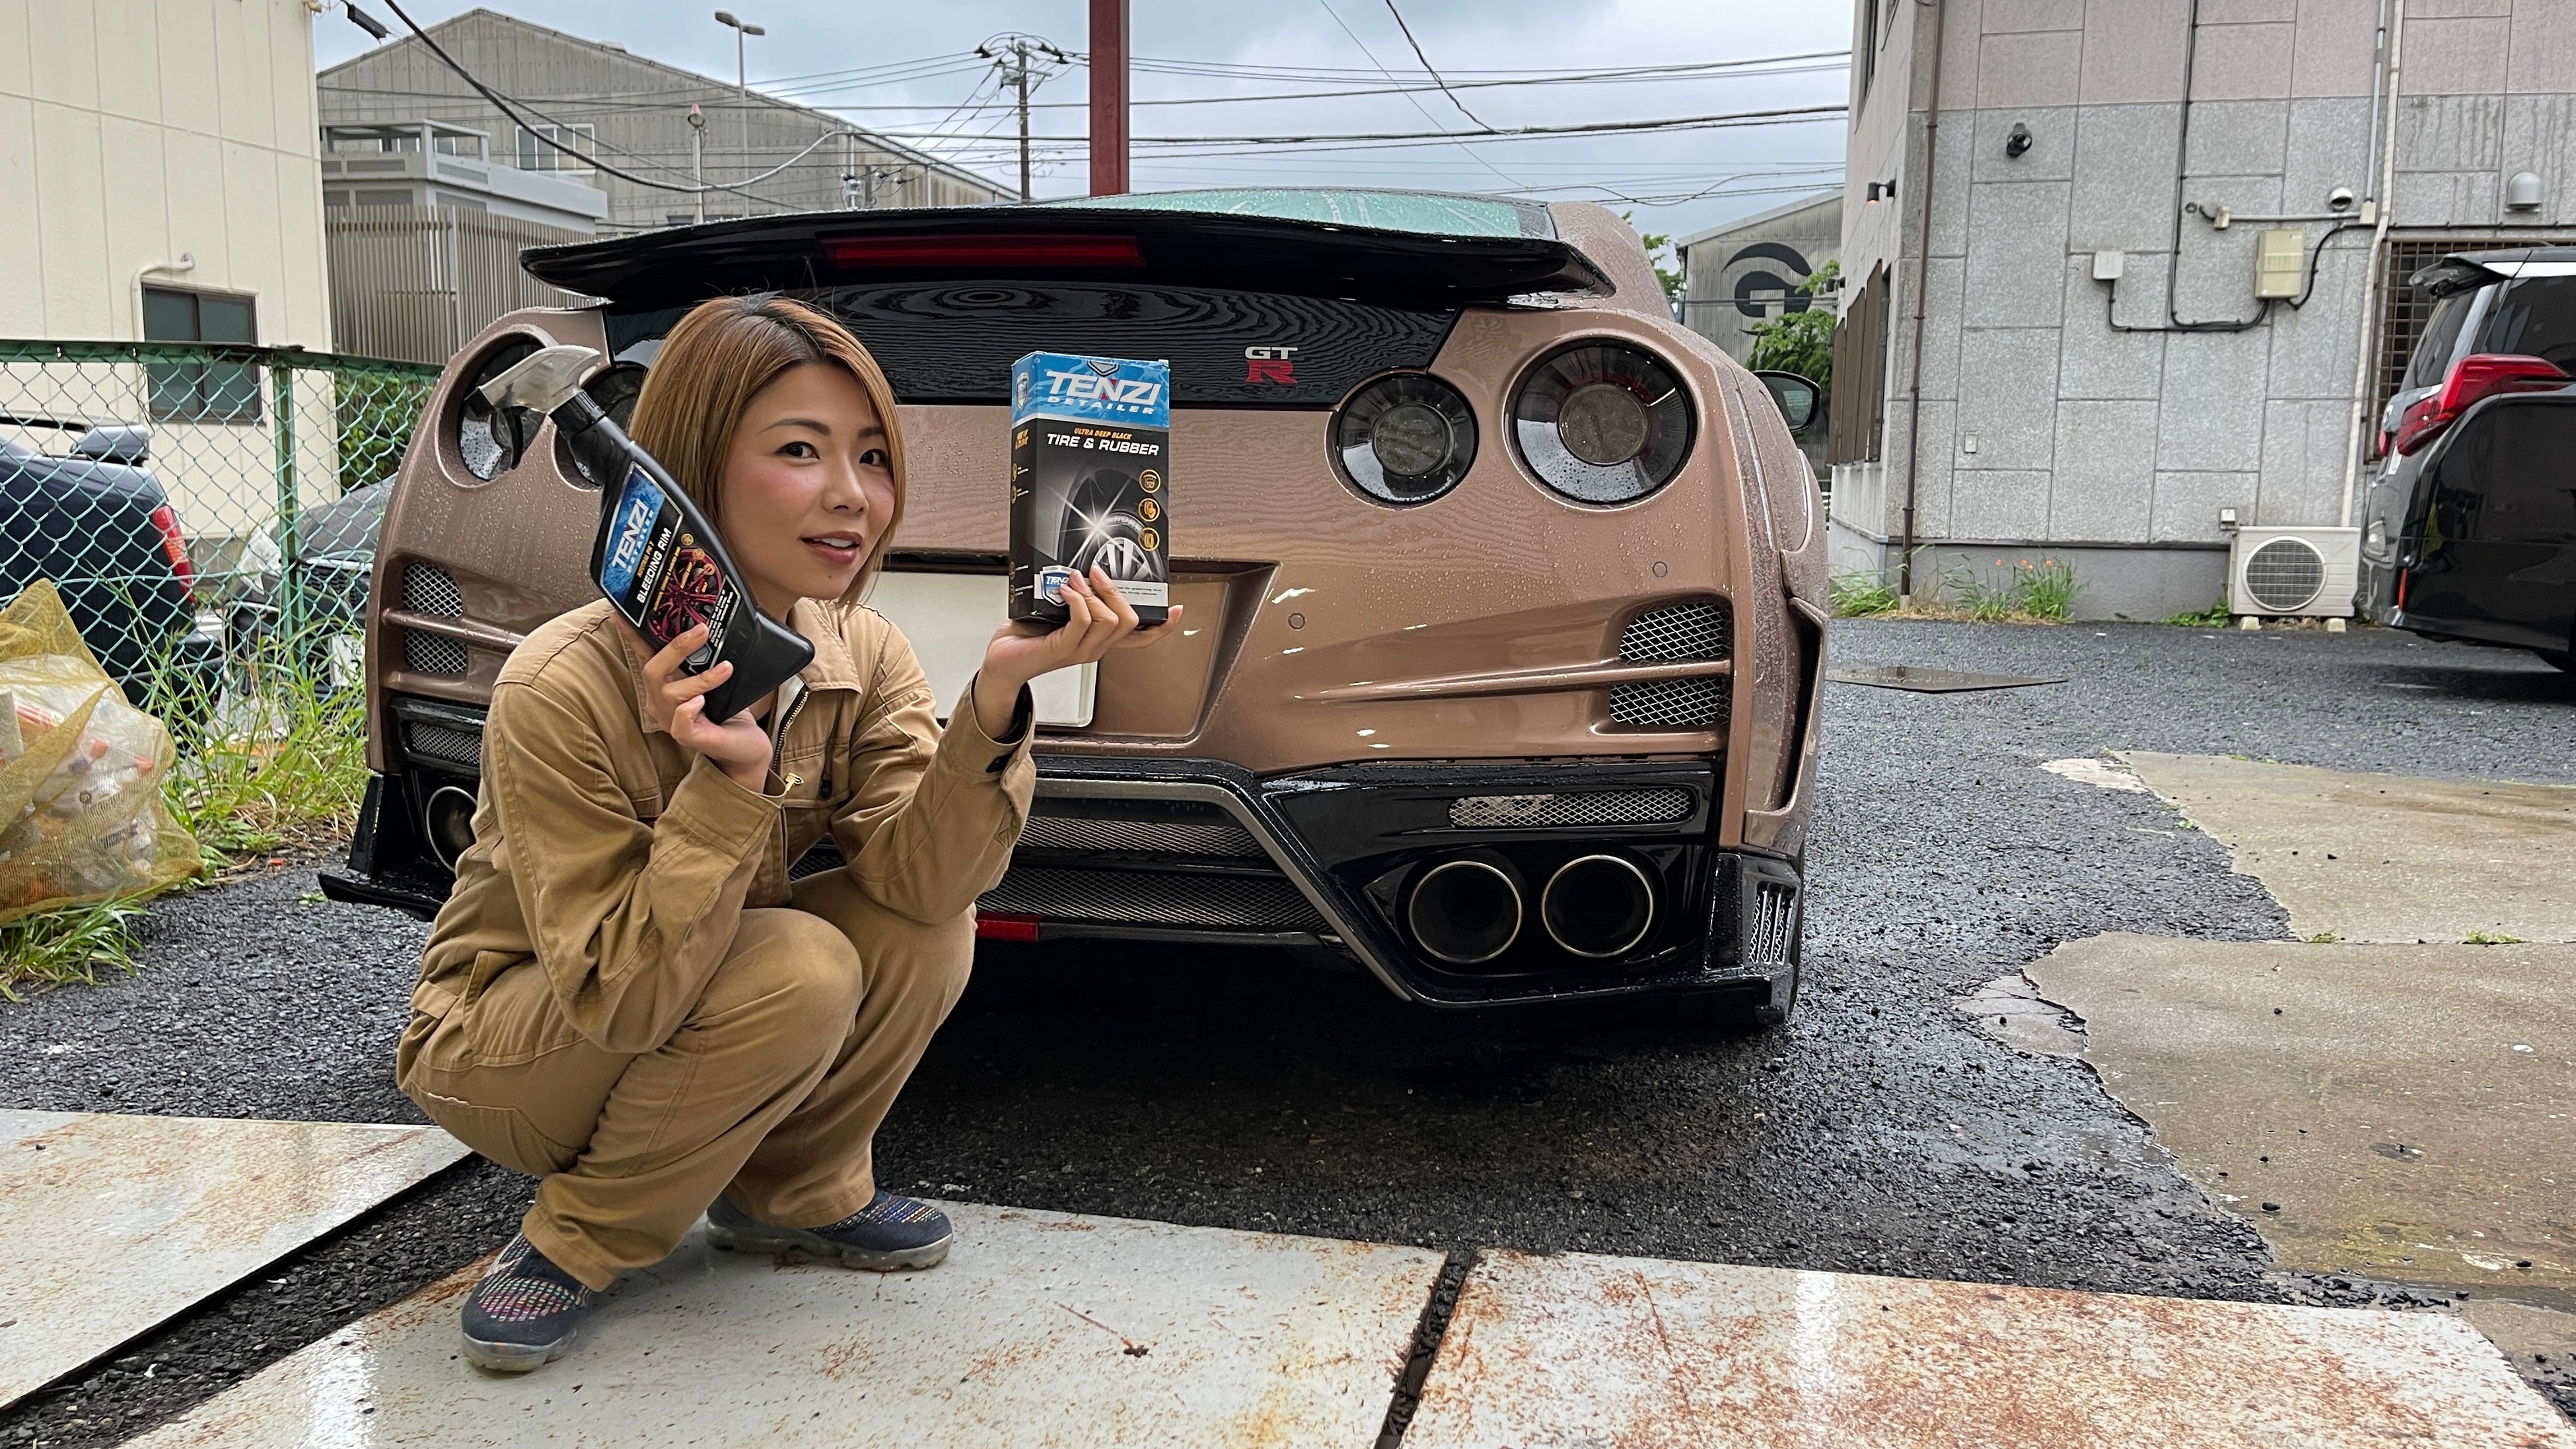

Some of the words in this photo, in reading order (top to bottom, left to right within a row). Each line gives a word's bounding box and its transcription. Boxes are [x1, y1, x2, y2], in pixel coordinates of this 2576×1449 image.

[1245, 347, 1298, 359] GT
[1245, 360, 1299, 384] R
[1046, 370, 1162, 406] TENZI
[1047, 395, 1155, 415] DETAILER
[1047, 433, 1081, 448] TIRE
[1083, 438, 1094, 449] &
[1098, 439, 1160, 456] RUBBER
[1074, 427, 1094, 437] ULTRA
[1094, 429, 1112, 438] DEEP
[1112, 431, 1133, 441] BLACK
[612, 497, 649, 569] TENZI
[626, 509, 655, 574] DETAILER
[636, 550, 662, 604] BLEEDING
[657, 527, 672, 551] RIM
[1046, 575, 1069, 584] TENZ
